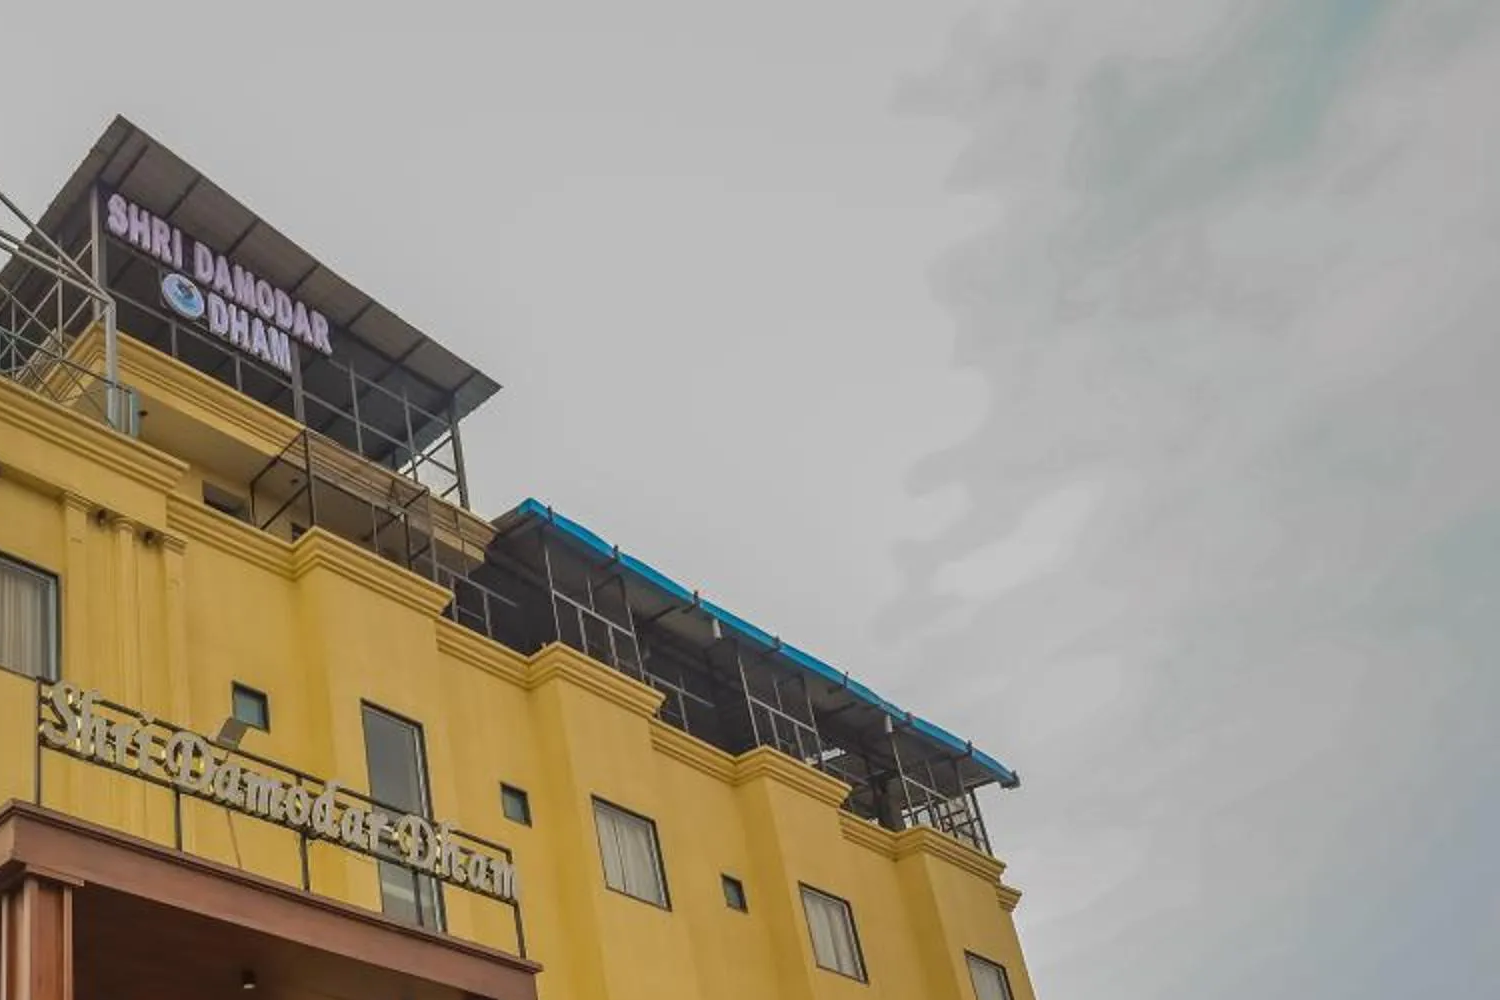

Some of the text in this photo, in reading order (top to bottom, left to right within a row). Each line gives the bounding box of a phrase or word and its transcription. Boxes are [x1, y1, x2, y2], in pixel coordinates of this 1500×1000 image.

[107, 193, 333, 354] SHRI DAMODAR
[207, 292, 292, 373] DHAM
[166, 731, 389, 852] Damodar
[397, 814, 517, 901] Dham
